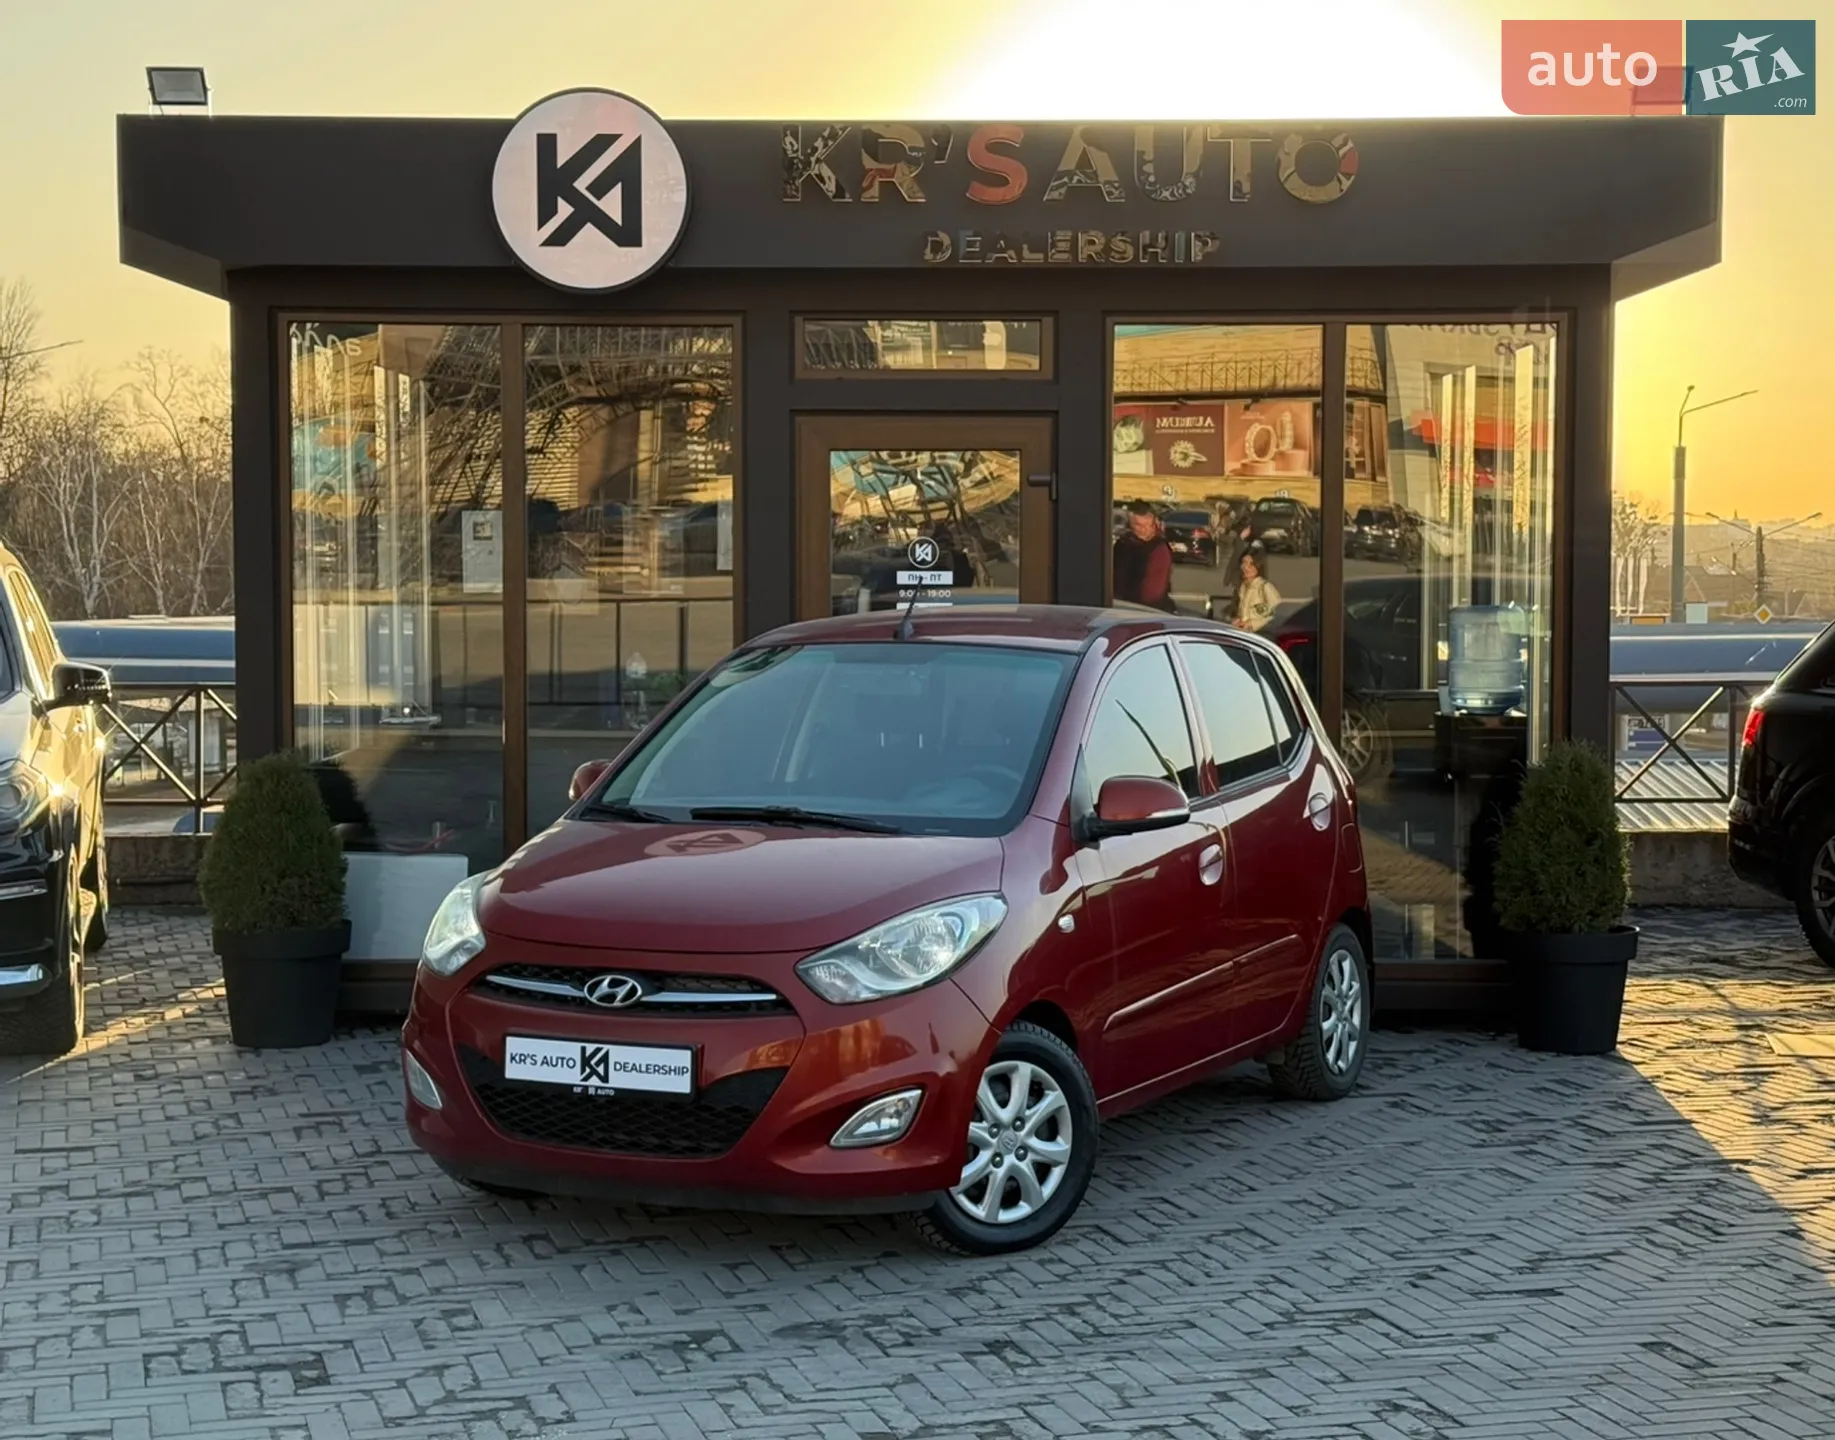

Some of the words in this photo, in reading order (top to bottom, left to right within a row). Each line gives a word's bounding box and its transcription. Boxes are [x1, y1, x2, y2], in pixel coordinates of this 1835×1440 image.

[782, 124, 1028, 203] KR'S
[1043, 124, 1359, 204] AUTO
[924, 230, 1221, 263] DEALERSHIP
[899, 589, 920, 598] 9:0
[927, 589, 951, 598] 19:00
[510, 1052, 538, 1066] KR'S
[540, 1055, 577, 1070] AUTO
[613, 1060, 690, 1077] DEALERSHIP
